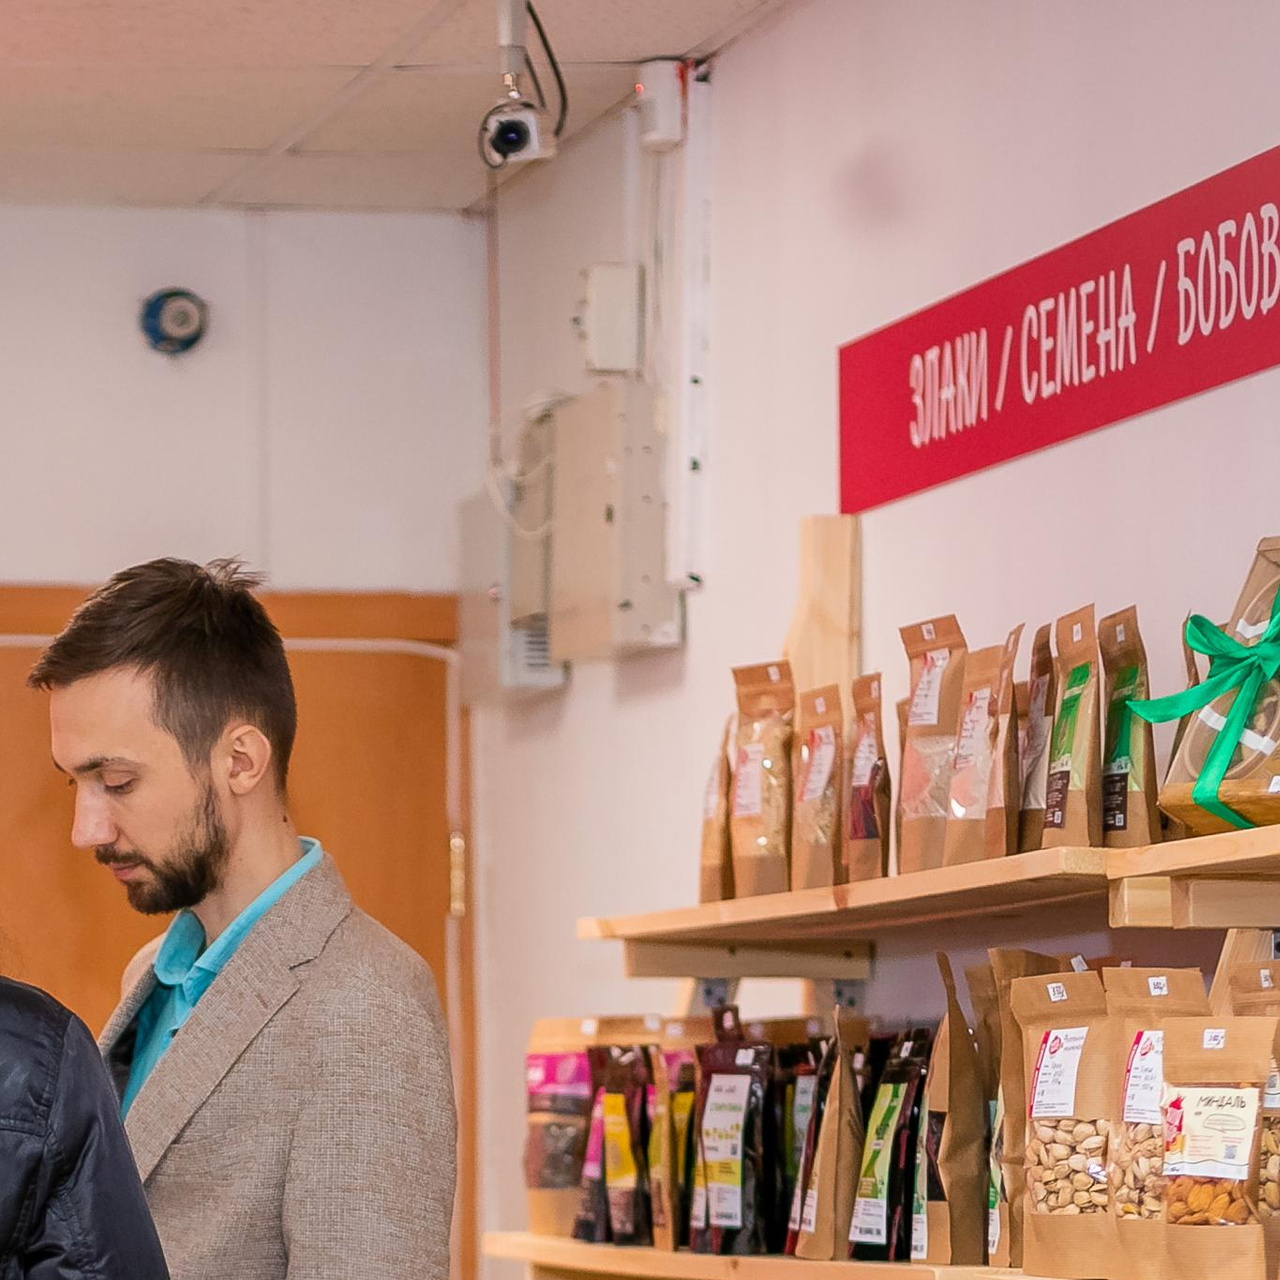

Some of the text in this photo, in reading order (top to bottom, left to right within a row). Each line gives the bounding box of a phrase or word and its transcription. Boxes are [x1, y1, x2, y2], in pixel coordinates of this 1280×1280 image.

[909, 328, 988, 448] ЗЛАКИ
[1020, 263, 1137, 404] СЕМЕНА
[1176, 202, 1280, 346] БОБОВ
[1197, 1095, 1246, 1109] МИНДАЛЬ
